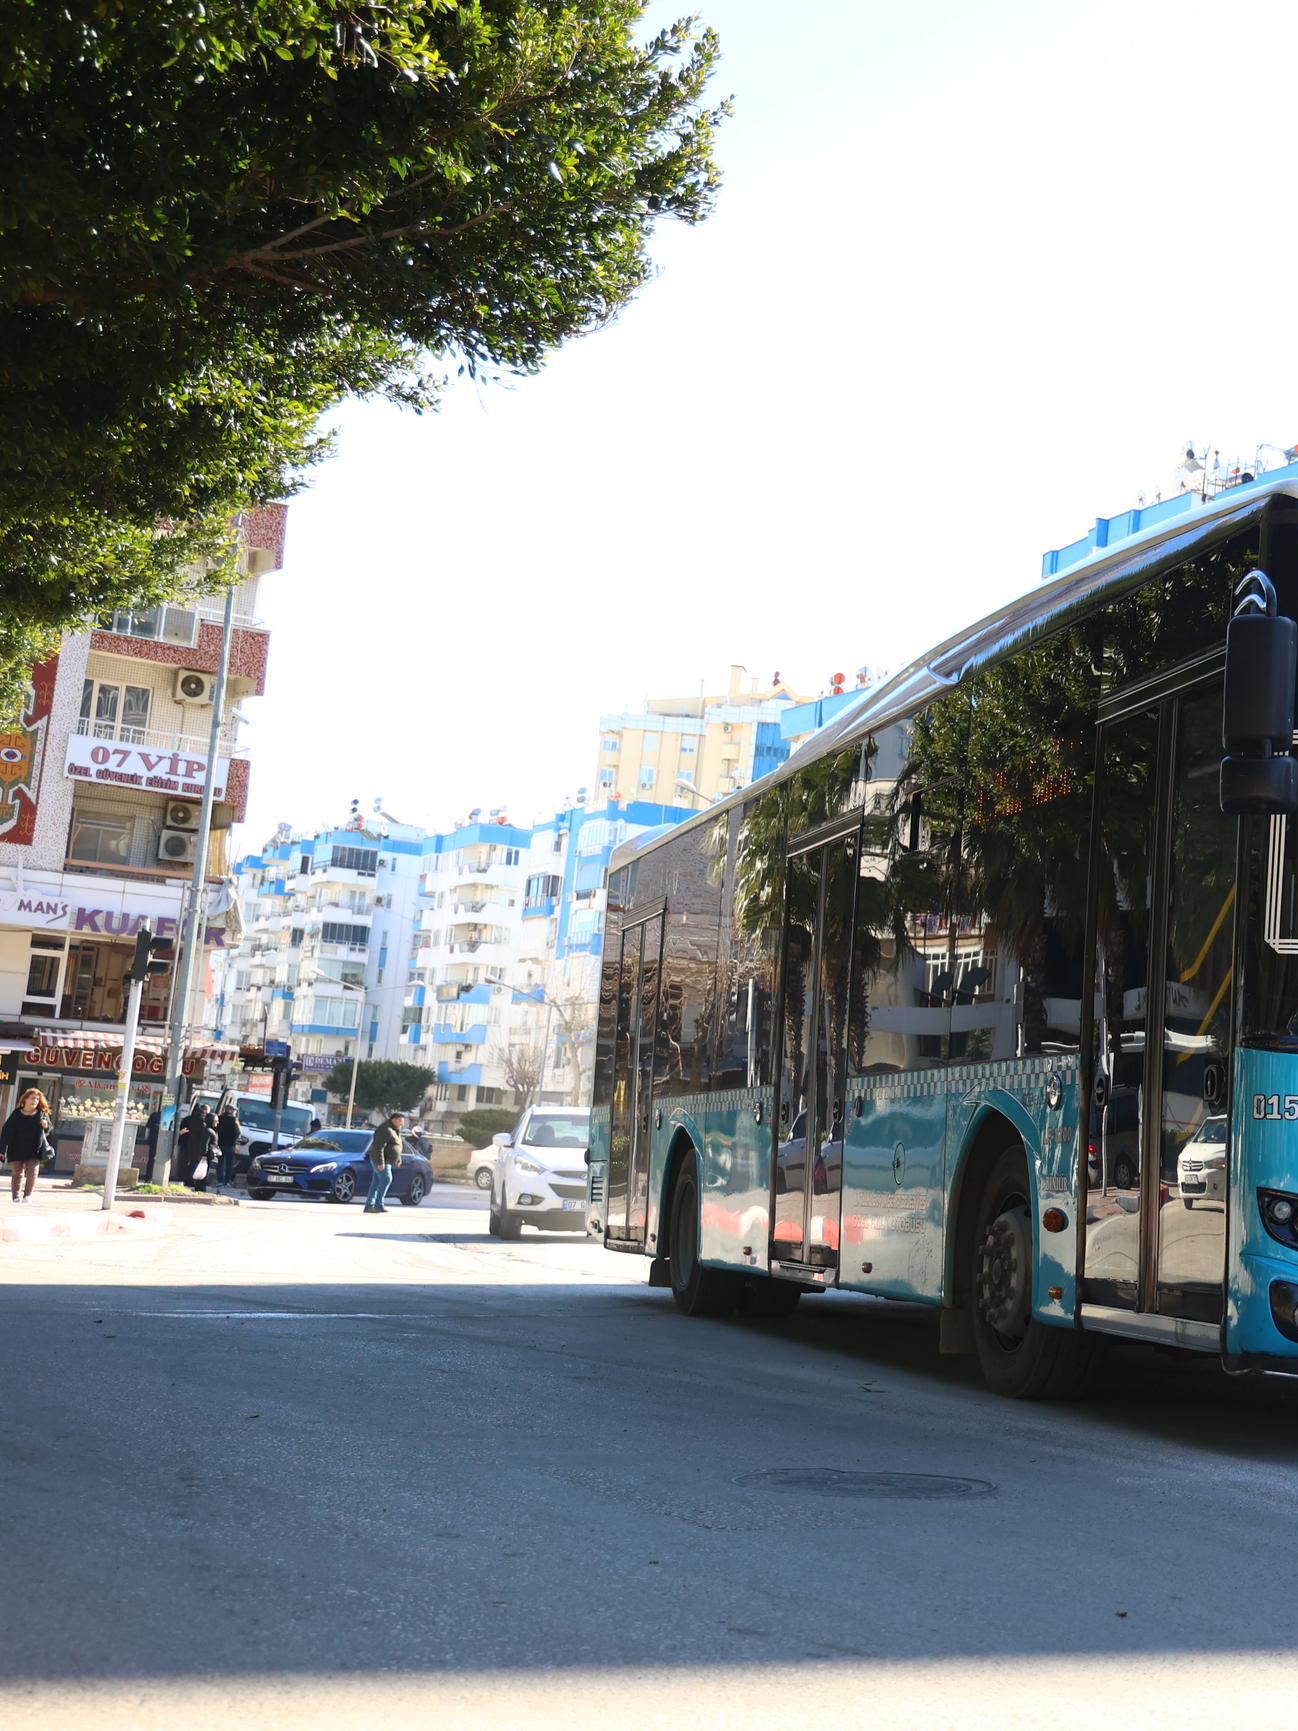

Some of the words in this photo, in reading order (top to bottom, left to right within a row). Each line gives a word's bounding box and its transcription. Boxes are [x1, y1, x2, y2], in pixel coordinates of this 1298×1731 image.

[91, 746, 132, 768] 07
[137, 752, 206, 779] VİP
[68, 762, 92, 778] ÖZEL
[96, 768, 144, 786] GÜVENLİK
[146, 775, 179, 790] EĞİTİM
[182, 783, 222, 798] KURU
[25, 1046, 196, 1076] GÜVENOĞU
